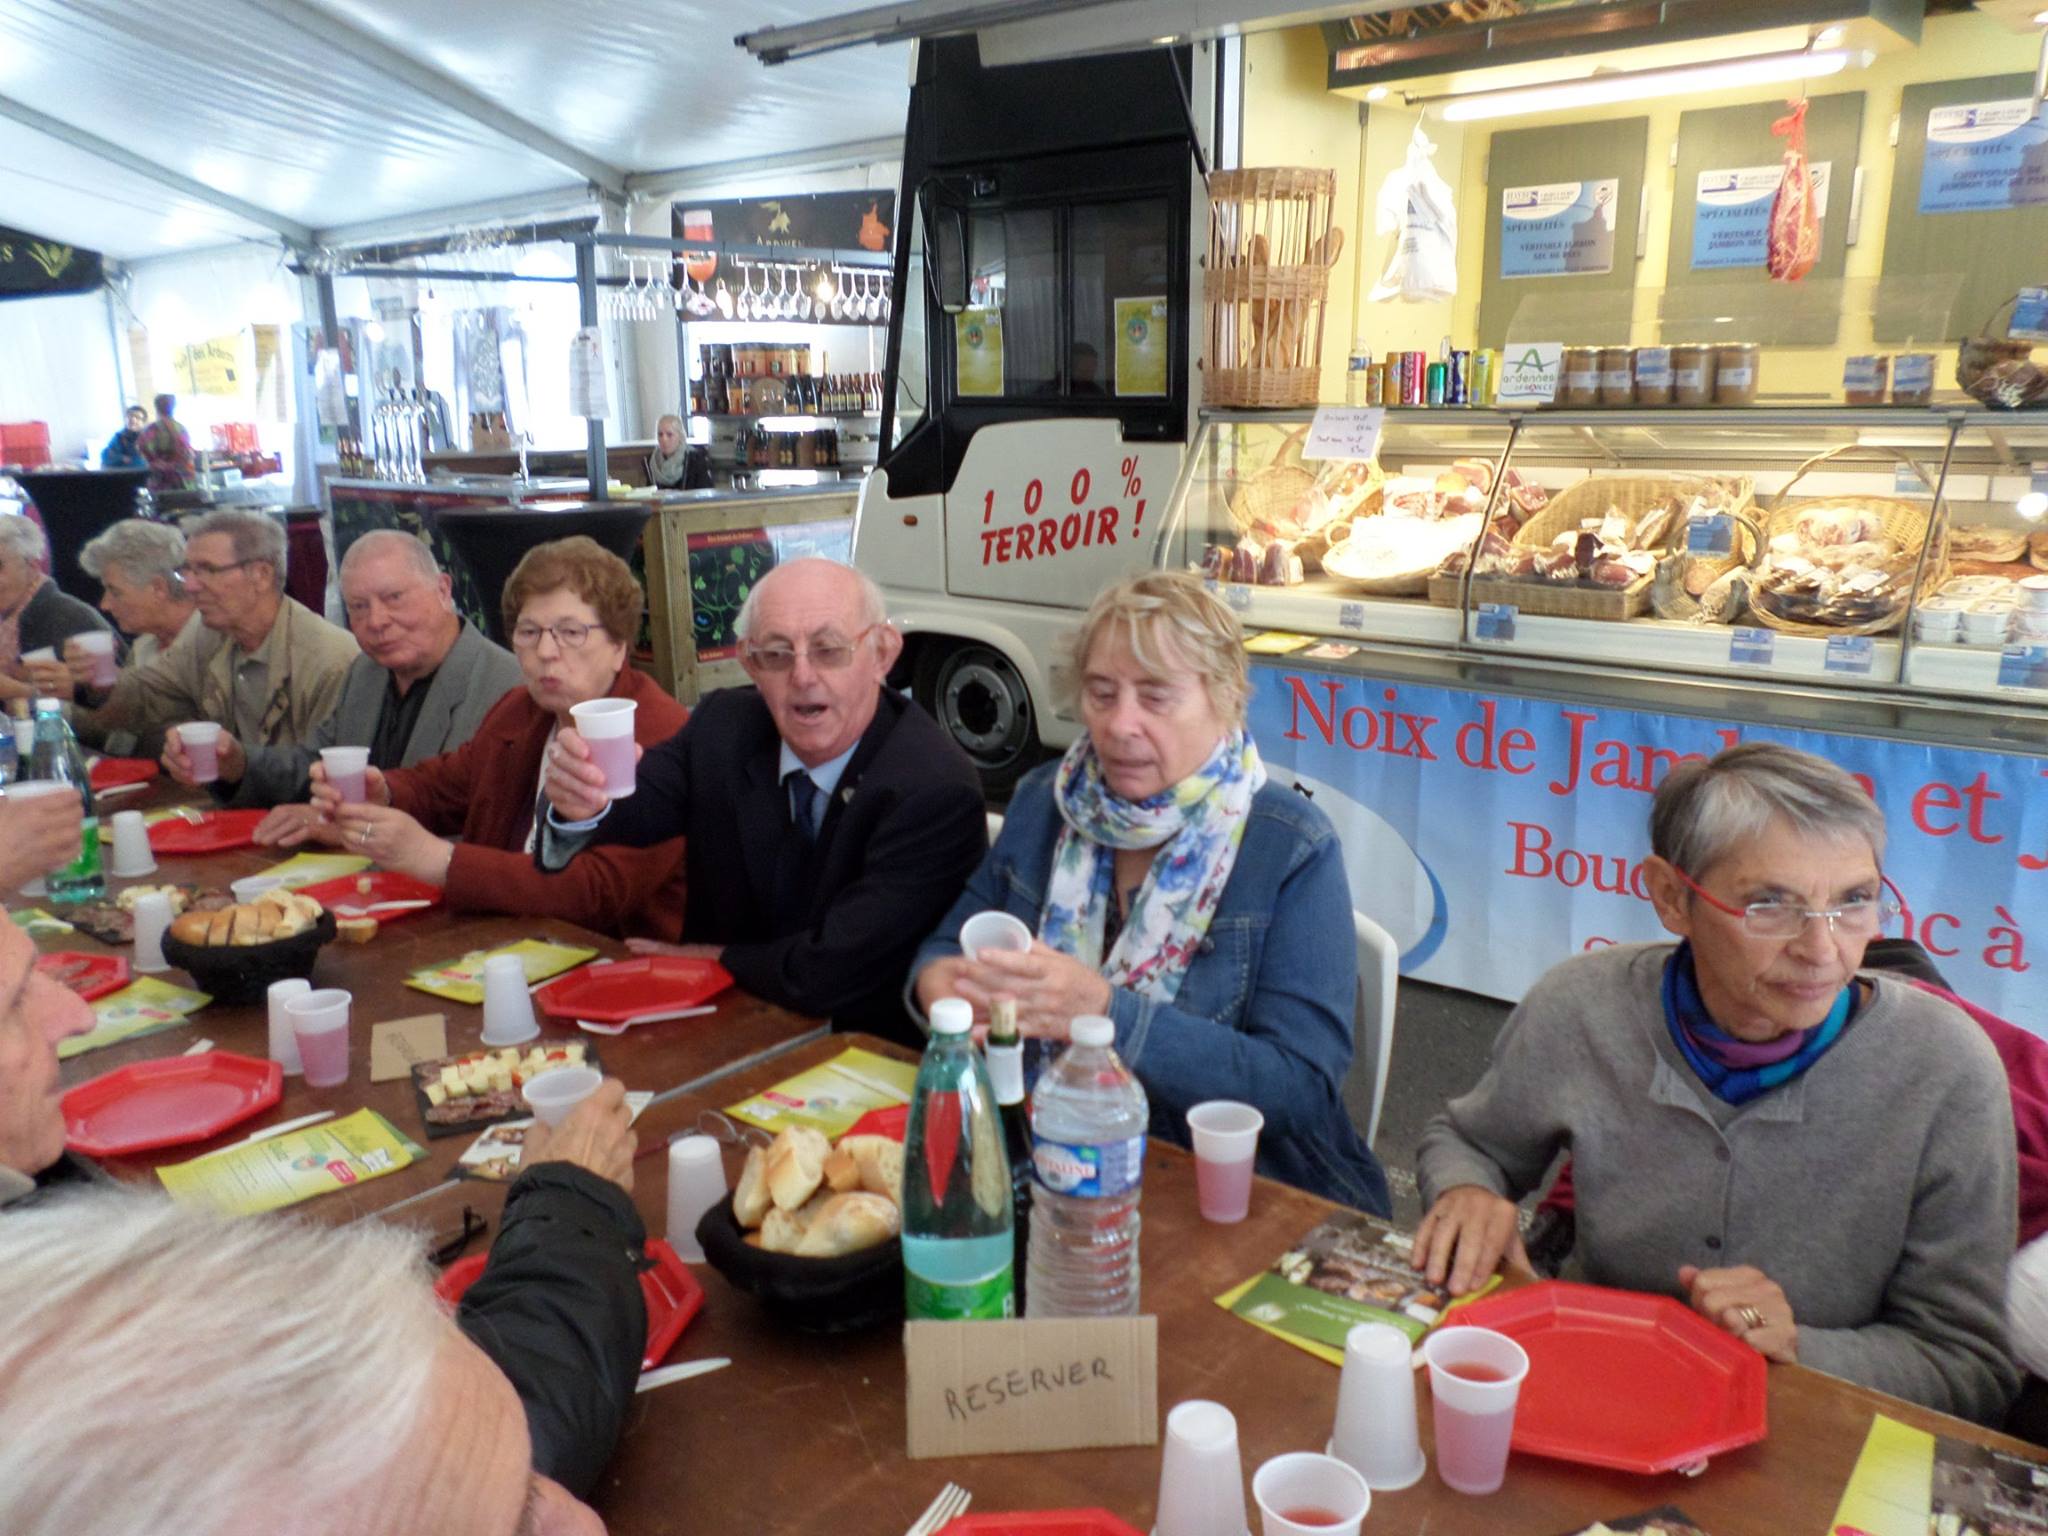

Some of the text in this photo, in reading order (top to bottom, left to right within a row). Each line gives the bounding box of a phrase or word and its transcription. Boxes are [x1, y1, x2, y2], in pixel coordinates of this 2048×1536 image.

[1283, 676, 1439, 761] Noix
[1455, 700, 1537, 775] de
[1910, 771, 2004, 844] et
[1982, 904, 2031, 972] à
[944, 1357, 1115, 1422] RESERVER
